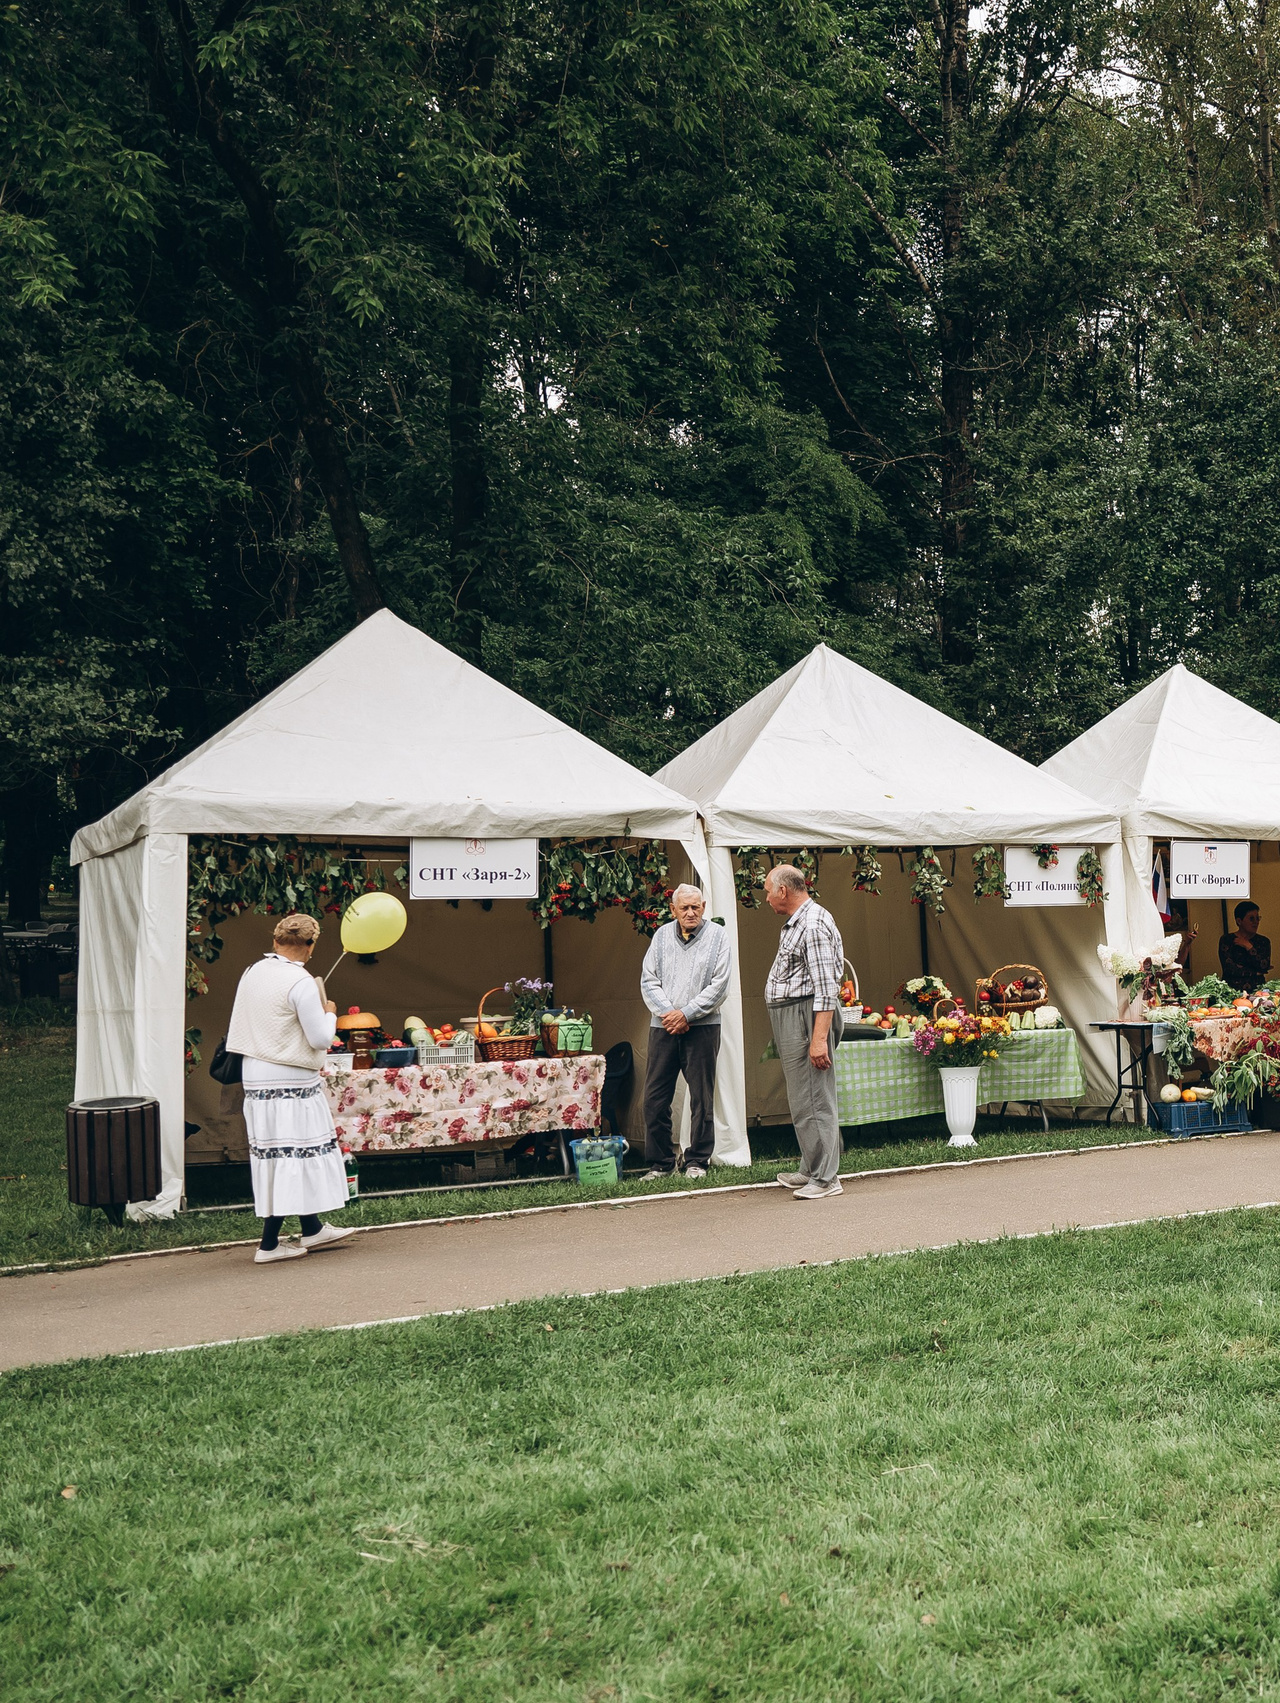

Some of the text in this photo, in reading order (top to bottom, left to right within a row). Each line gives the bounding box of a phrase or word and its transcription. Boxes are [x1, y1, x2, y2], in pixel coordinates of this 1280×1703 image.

[419, 868, 531, 883] СНТ «Заря-2»
[1176, 874, 1245, 887] СНТ «Воря-1»
[1009, 881, 1081, 892] СНТ «Полянк
